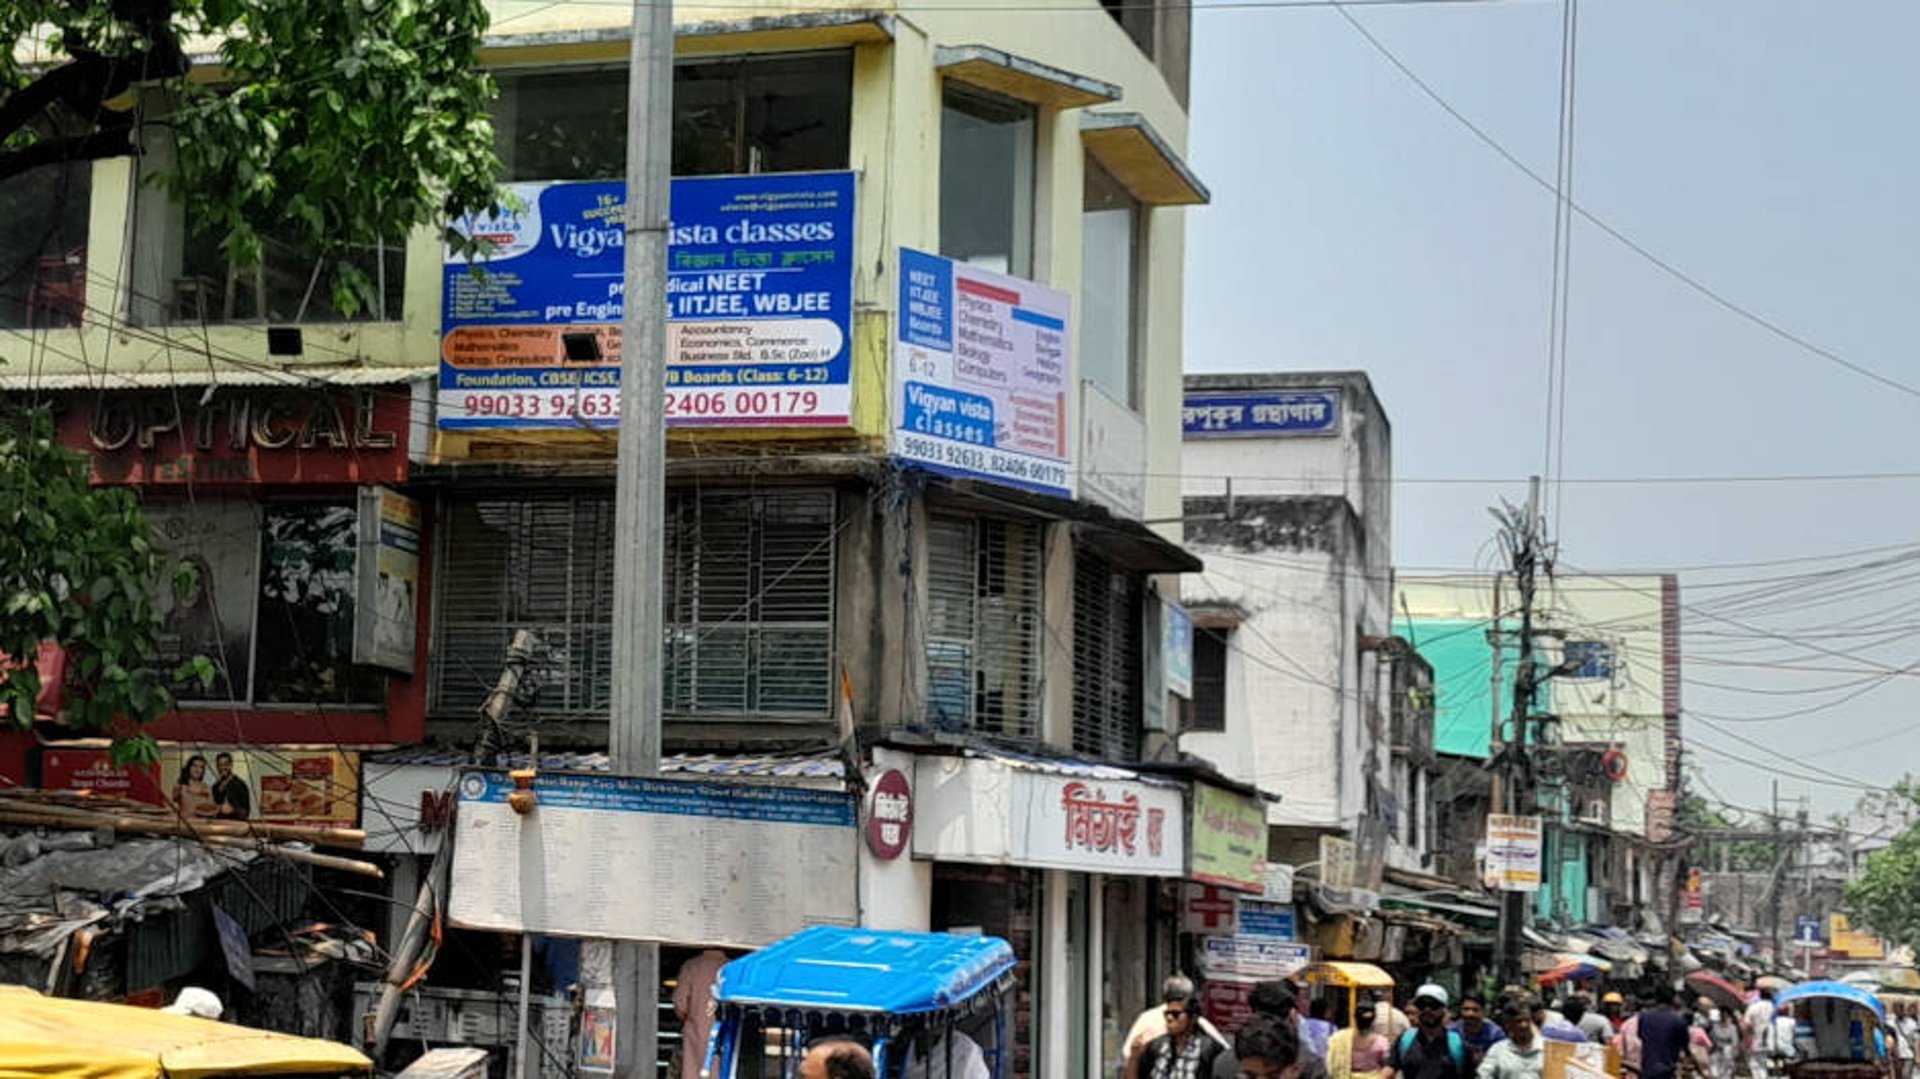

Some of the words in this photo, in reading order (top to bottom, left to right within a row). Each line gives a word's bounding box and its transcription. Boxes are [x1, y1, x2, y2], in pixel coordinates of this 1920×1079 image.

[550, 223, 624, 257] Vigya
[667, 221, 718, 246] ista
[725, 219, 834, 243] classes
[707, 273, 767, 291] NEET
[545, 304, 571, 320] pre
[679, 294, 749, 316] IITJEE,
[753, 292, 832, 312] WBJEE
[680, 324, 752, 336] Accountancy
[456, 373, 537, 387] Foundation,
[683, 369, 733, 383] Boards
[464, 394, 540, 416] 99033
[664, 392, 726, 415] 2406
[735, 391, 818, 414] 00179
[907, 384, 957, 414] Vigyan
[89, 394, 397, 449] OPTICAL
[915, 408, 985, 443] classes
[903, 437, 943, 462] 99033
[1062, 782, 1139, 856] মিঠাই
